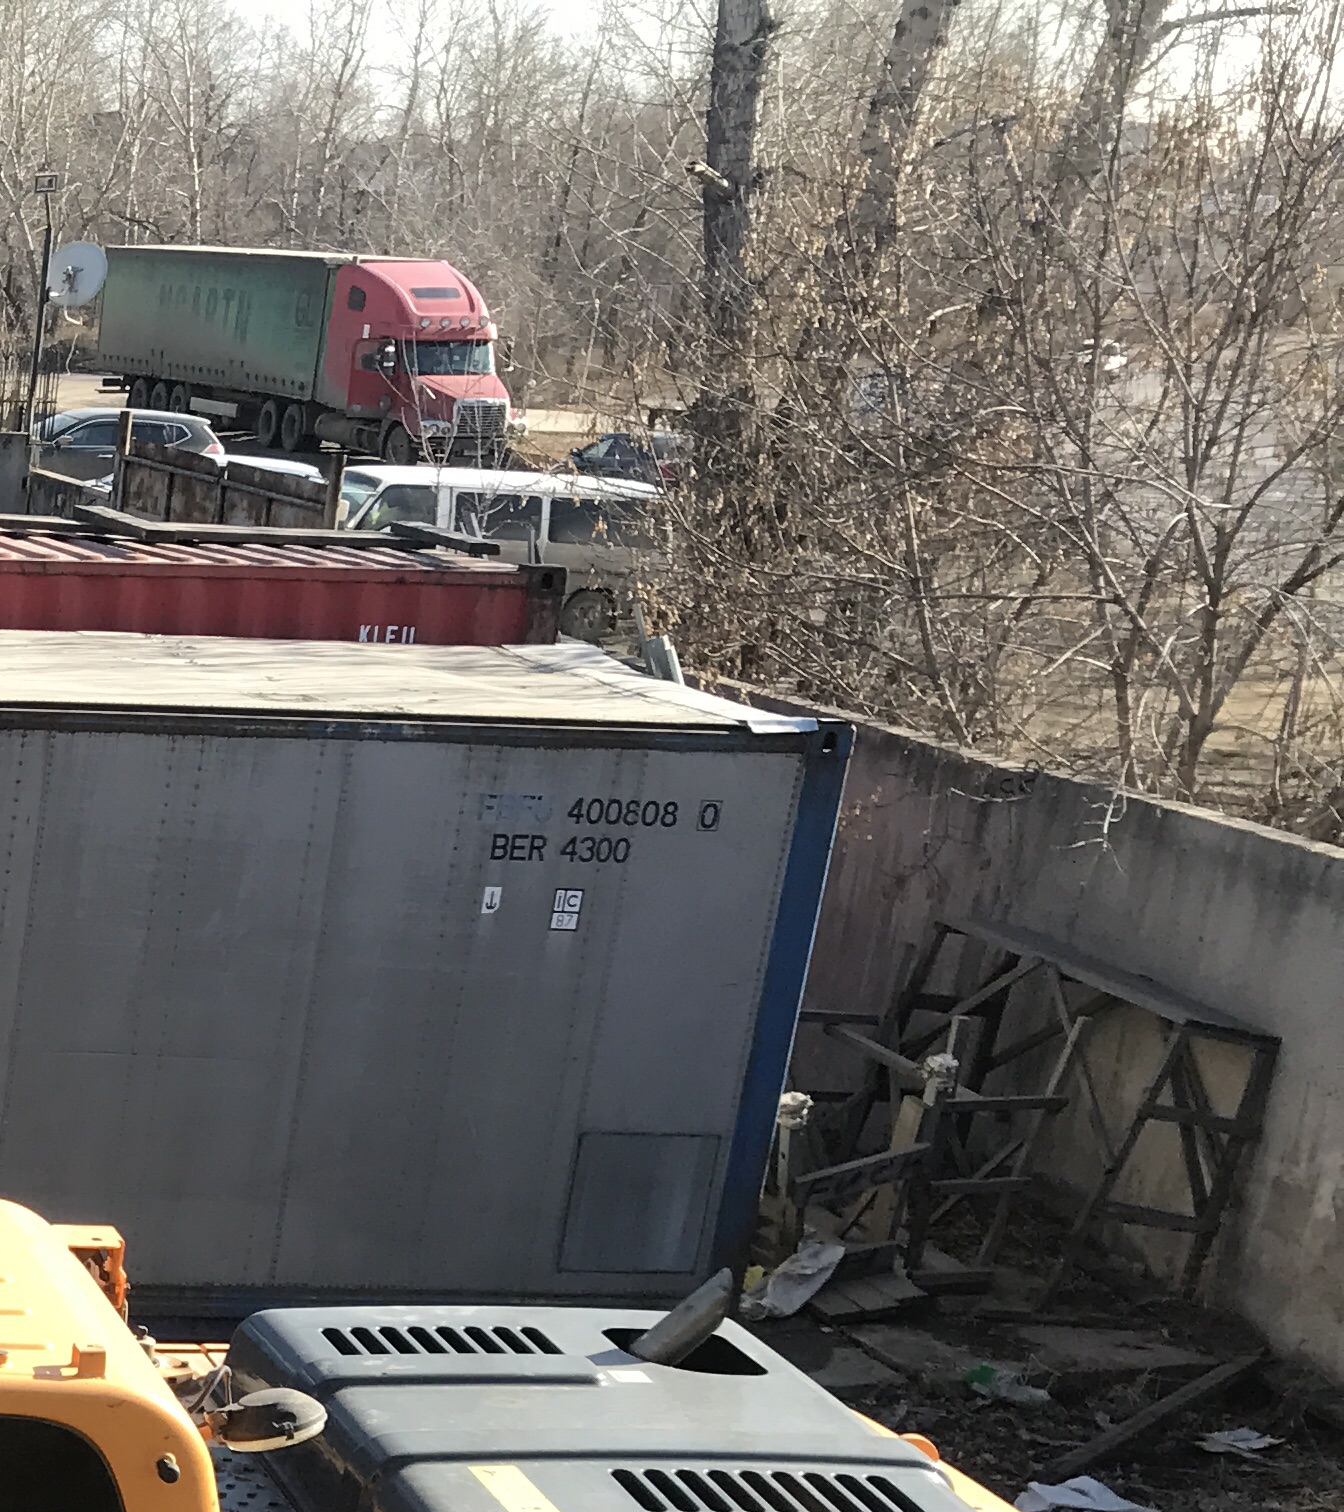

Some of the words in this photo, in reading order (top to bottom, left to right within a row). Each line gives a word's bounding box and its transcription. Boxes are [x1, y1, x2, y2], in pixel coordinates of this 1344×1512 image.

[568, 798, 678, 827] 400808
[490, 834, 547, 861] BER
[560, 836, 631, 863] 4300
[555, 914, 574, 927] 87
